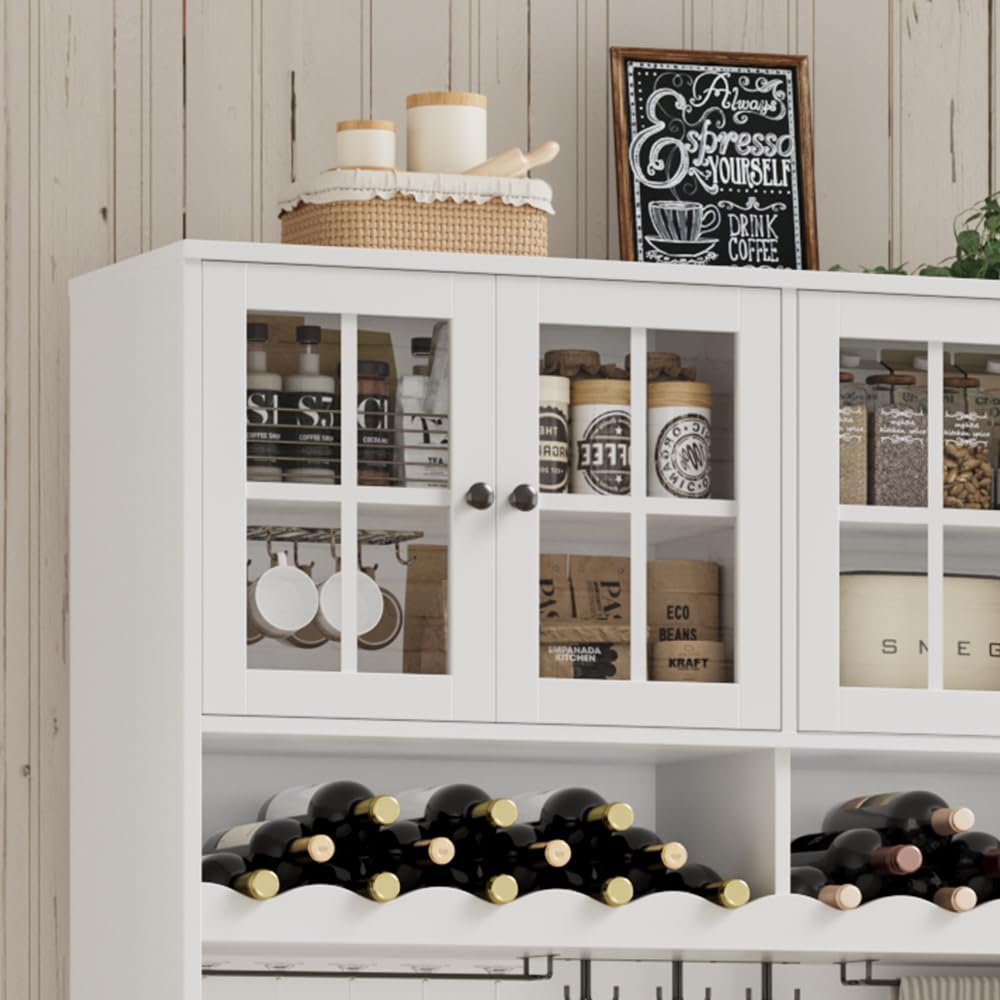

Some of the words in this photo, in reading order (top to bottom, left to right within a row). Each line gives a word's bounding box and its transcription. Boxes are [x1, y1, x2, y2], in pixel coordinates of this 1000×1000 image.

[629, 88, 792, 188] Espresso
[709, 157, 791, 188] YOURSELF
[728, 213, 779, 238] DRINK
[728, 238, 780, 262] COFFEE
[667, 605, 690, 621] ECO
[659, 627, 698, 642] BEANS
[555, 653, 596, 663] KITCHEN
[669, 658, 709, 668] KRAFT
